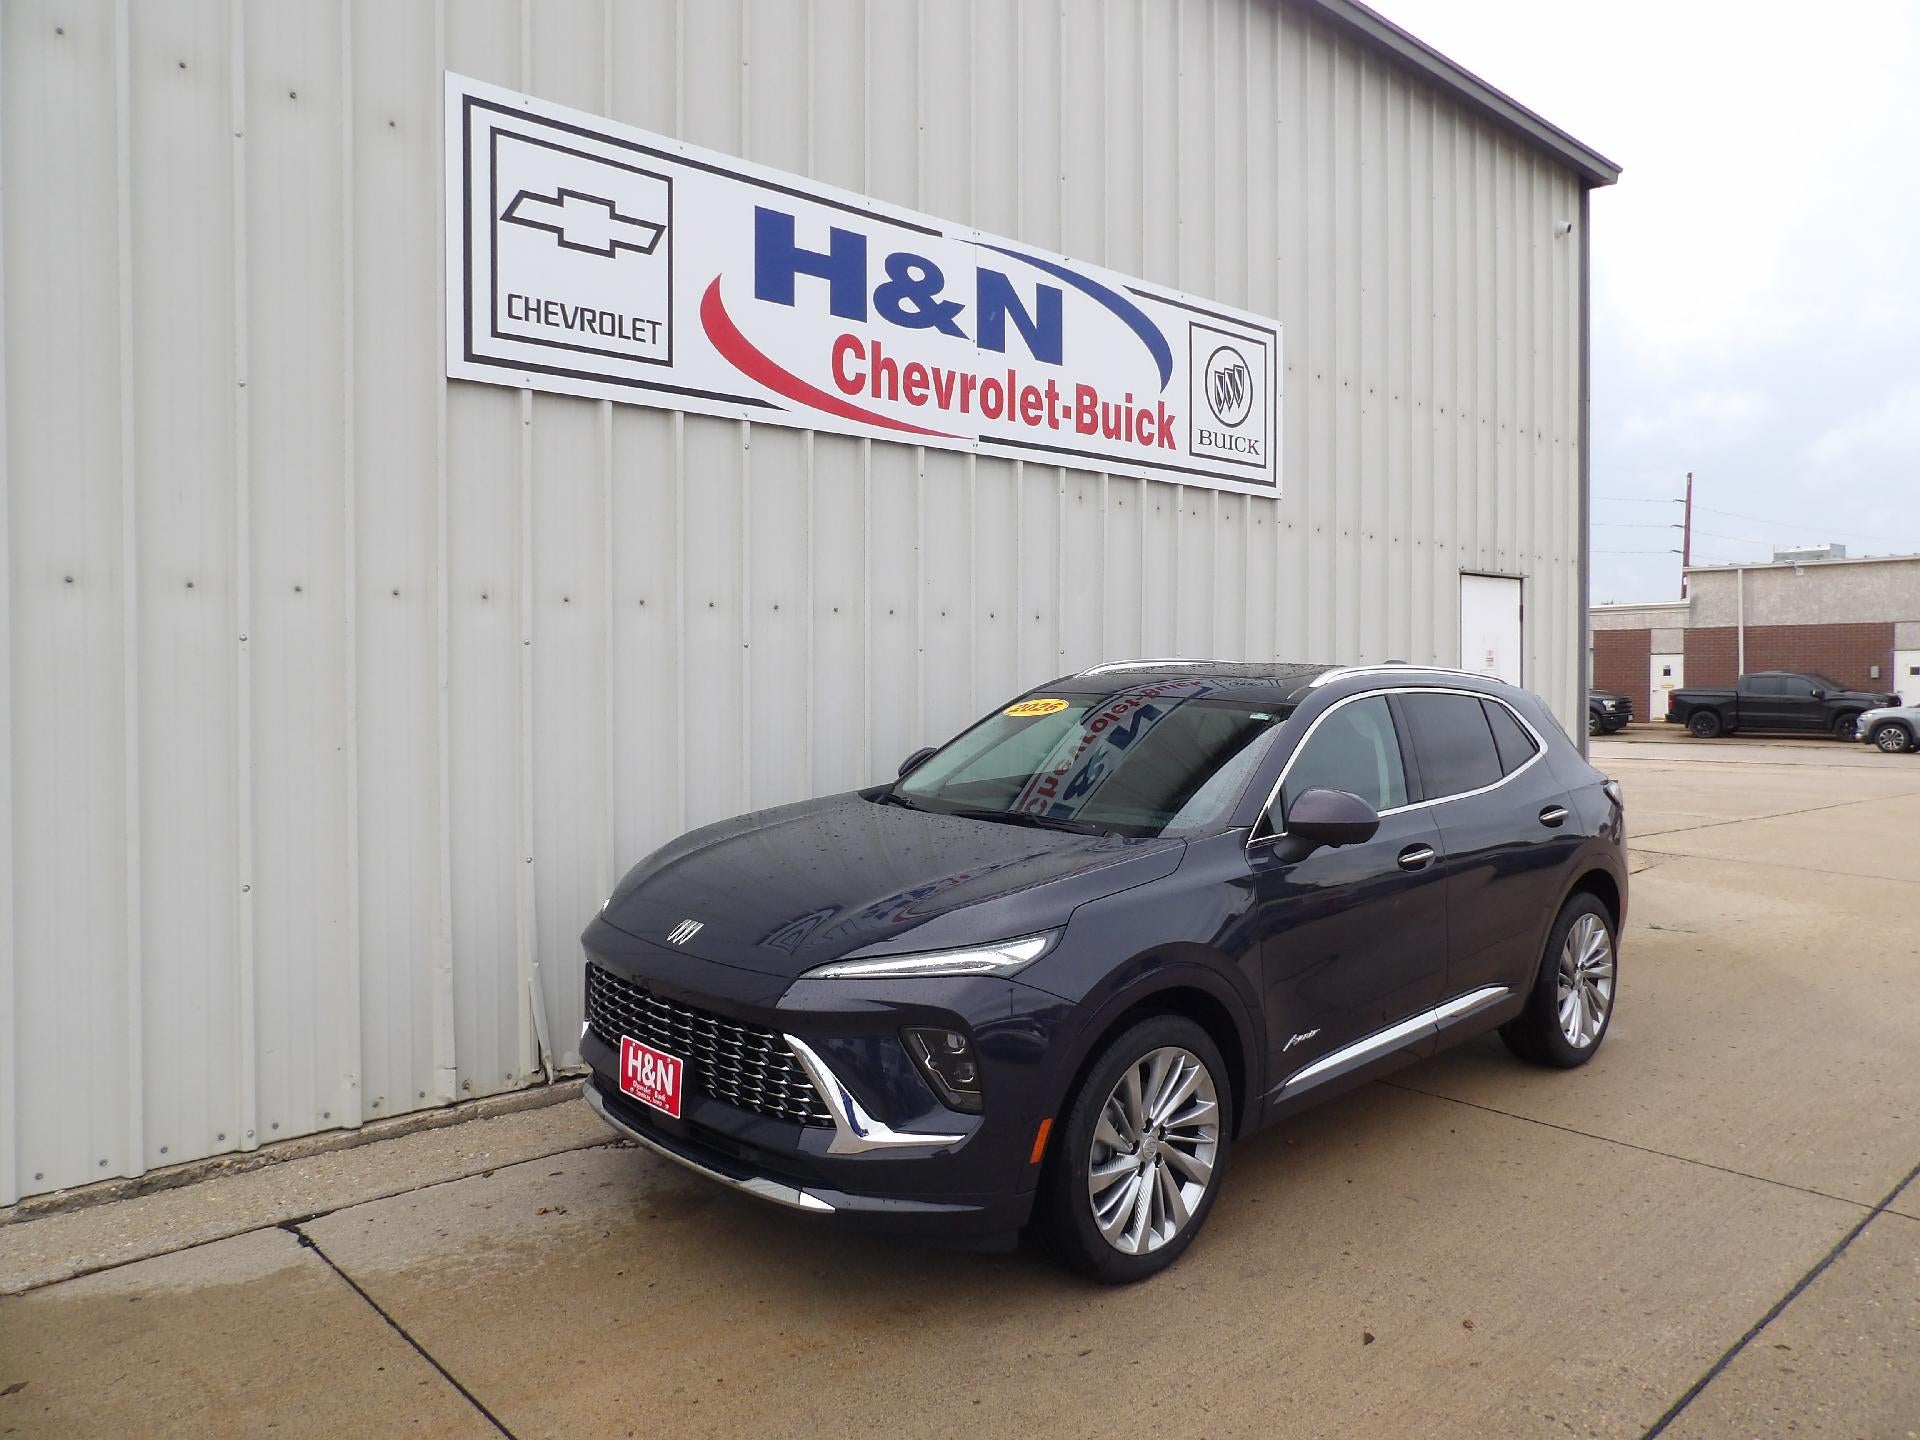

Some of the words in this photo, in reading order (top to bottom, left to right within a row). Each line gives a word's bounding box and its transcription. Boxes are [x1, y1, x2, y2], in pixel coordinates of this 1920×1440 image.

[755, 205, 1063, 366] H&N
[507, 293, 663, 345] CHEVROLET
[832, 333, 1177, 450] Chevrolet-Buick
[1198, 428, 1260, 456] BUICK
[628, 1045, 674, 1097] H&N
